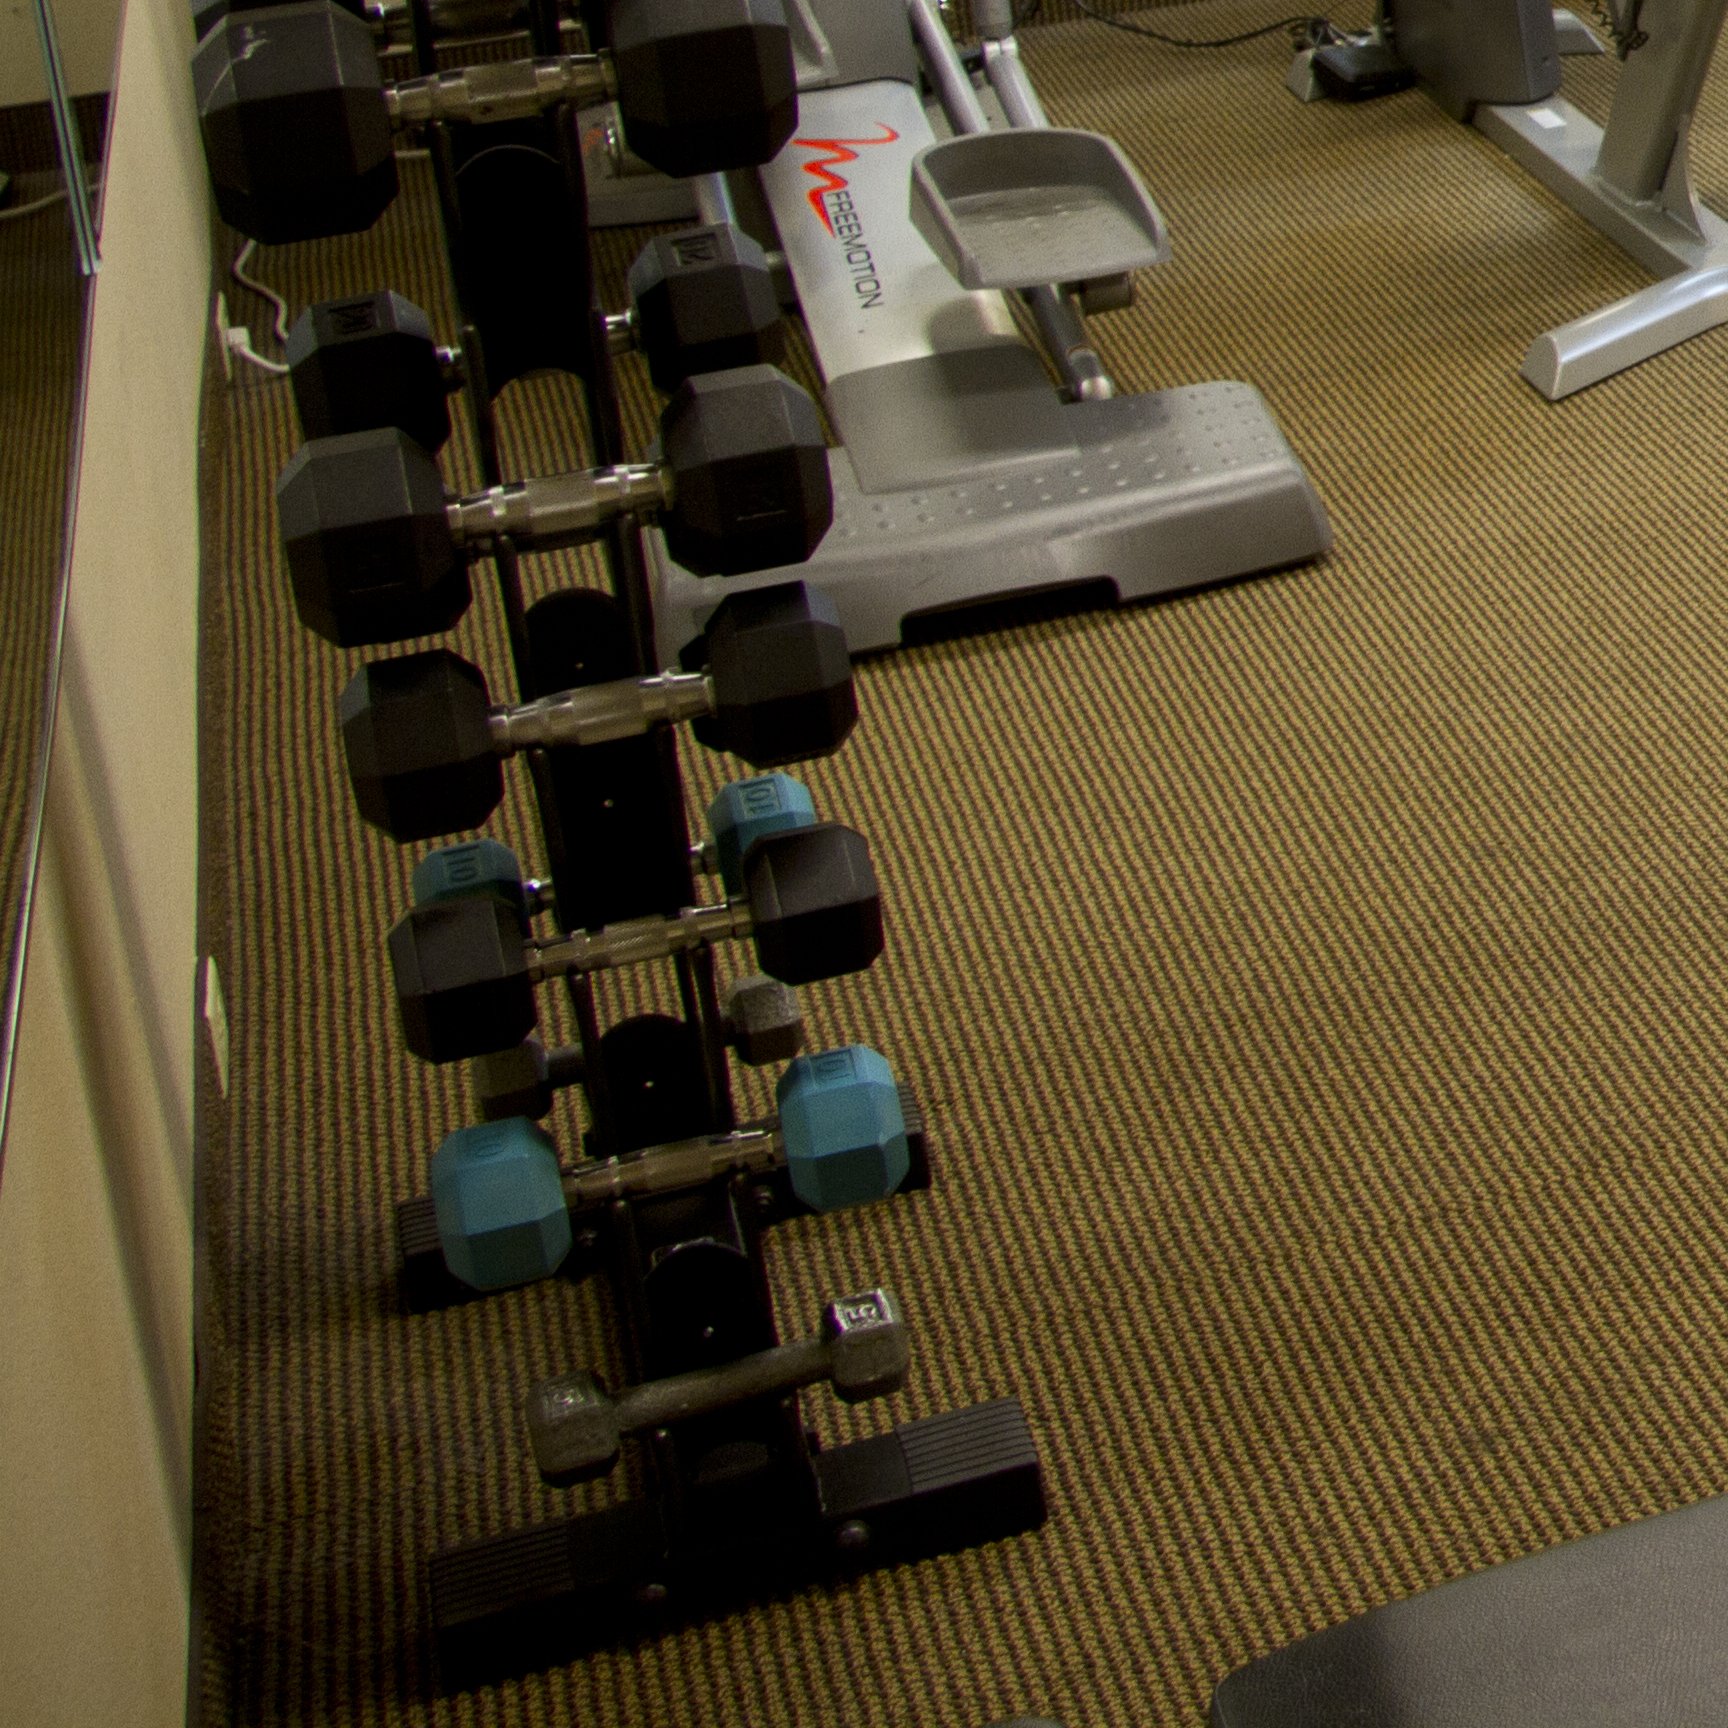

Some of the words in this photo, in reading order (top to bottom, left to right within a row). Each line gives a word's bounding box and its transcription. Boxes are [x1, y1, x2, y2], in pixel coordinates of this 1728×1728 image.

[826, 189, 886, 311] FREEMOTION
[745, 787, 775, 814] 10
[447, 856, 480, 882] 10
